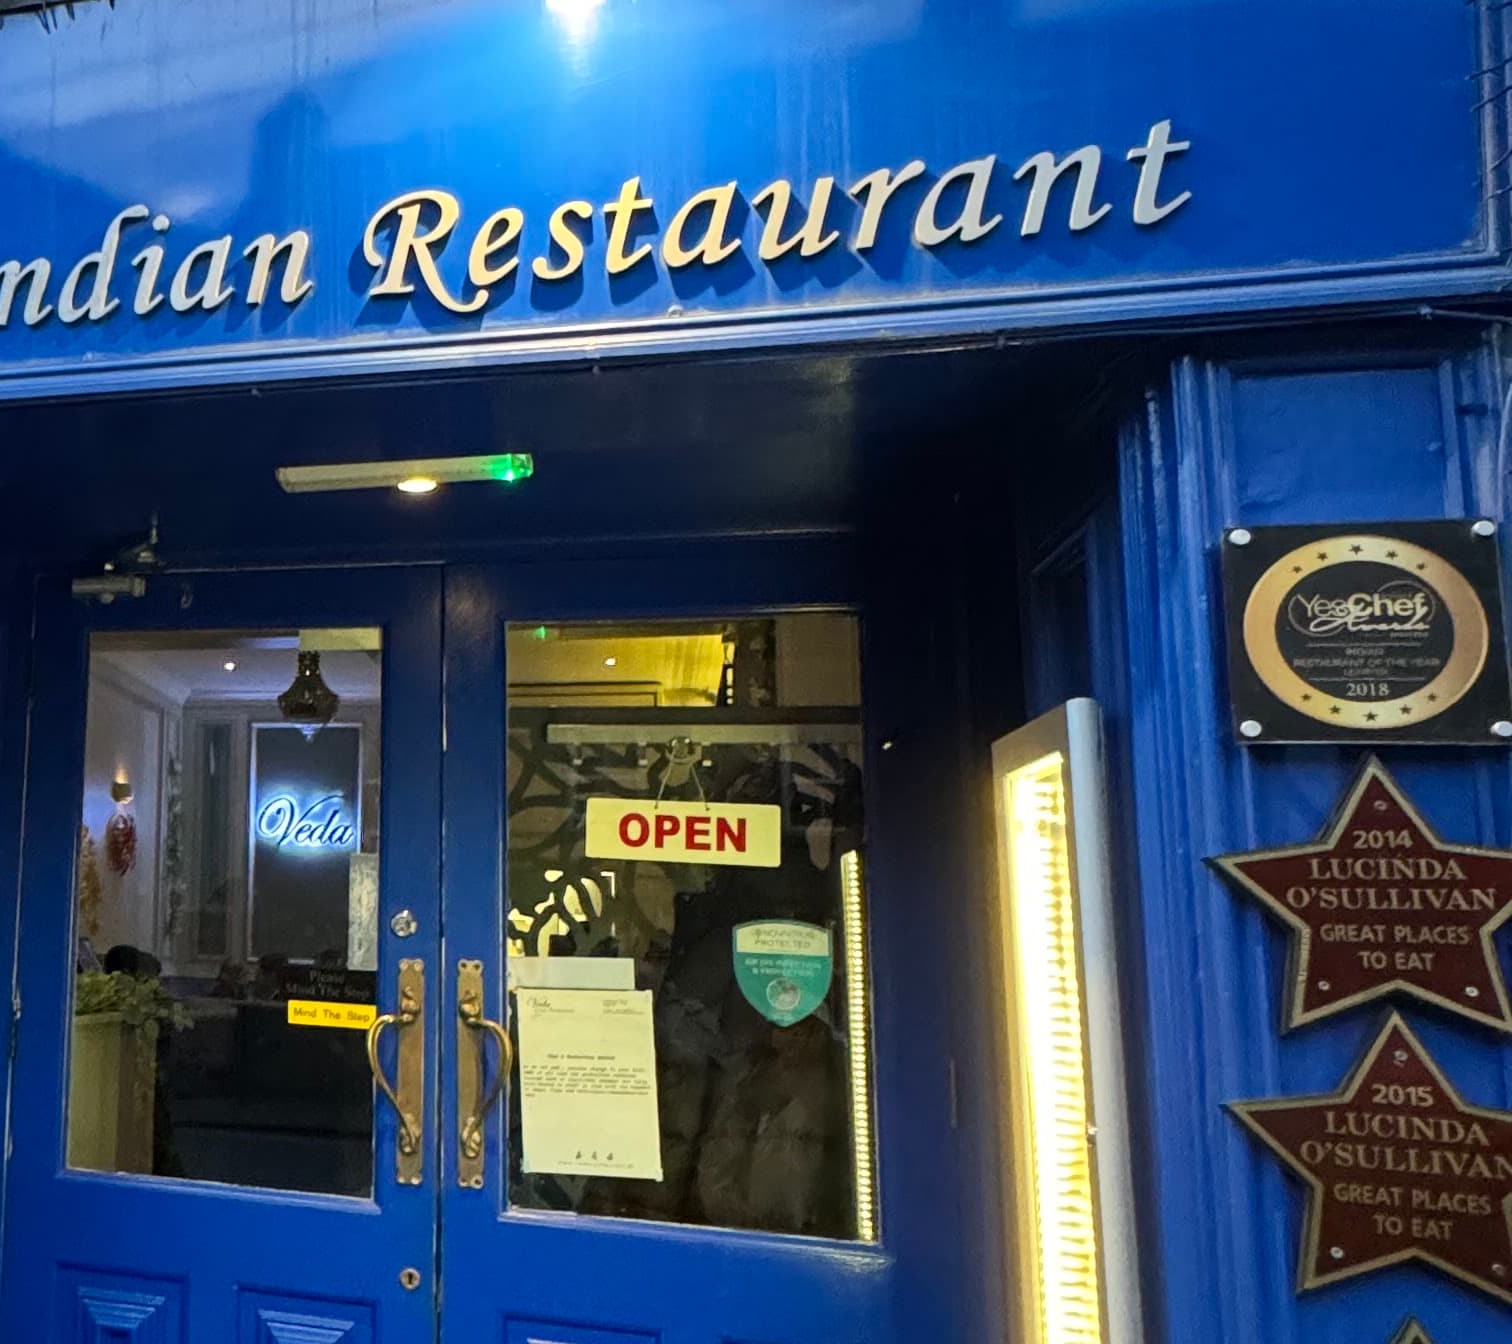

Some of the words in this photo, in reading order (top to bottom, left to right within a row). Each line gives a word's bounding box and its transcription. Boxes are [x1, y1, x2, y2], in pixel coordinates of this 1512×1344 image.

[363, 117, 1194, 314] Restaurant
[1345, 683, 1390, 697] 2018
[259, 794, 355, 847] Veda
[618, 812, 747, 853] OPEN
[1352, 829, 1414, 850] 2014
[1308, 857, 1467, 881] LUCINDA
[1286, 886, 1497, 911] O'SULLIVAN
[1319, 923, 1387, 944] GREAT
[1393, 924, 1472, 945] PLACES
[1357, 951, 1388, 970] TO
[1394, 951, 1436, 972] EAT
[293, 1007, 318, 1019] Mind
[322, 1009, 342, 1020] The
[346, 1010, 371, 1023] Step
[1371, 1083, 1435, 1107] 2015
[1324, 1110, 1490, 1147] LUCINDA
[1333, 1182, 1404, 1206] GREAT
[1411, 1188, 1492, 1216] PLACES
[1372, 1214, 1404, 1236] TO
[1411, 1218, 1454, 1241] EAT
